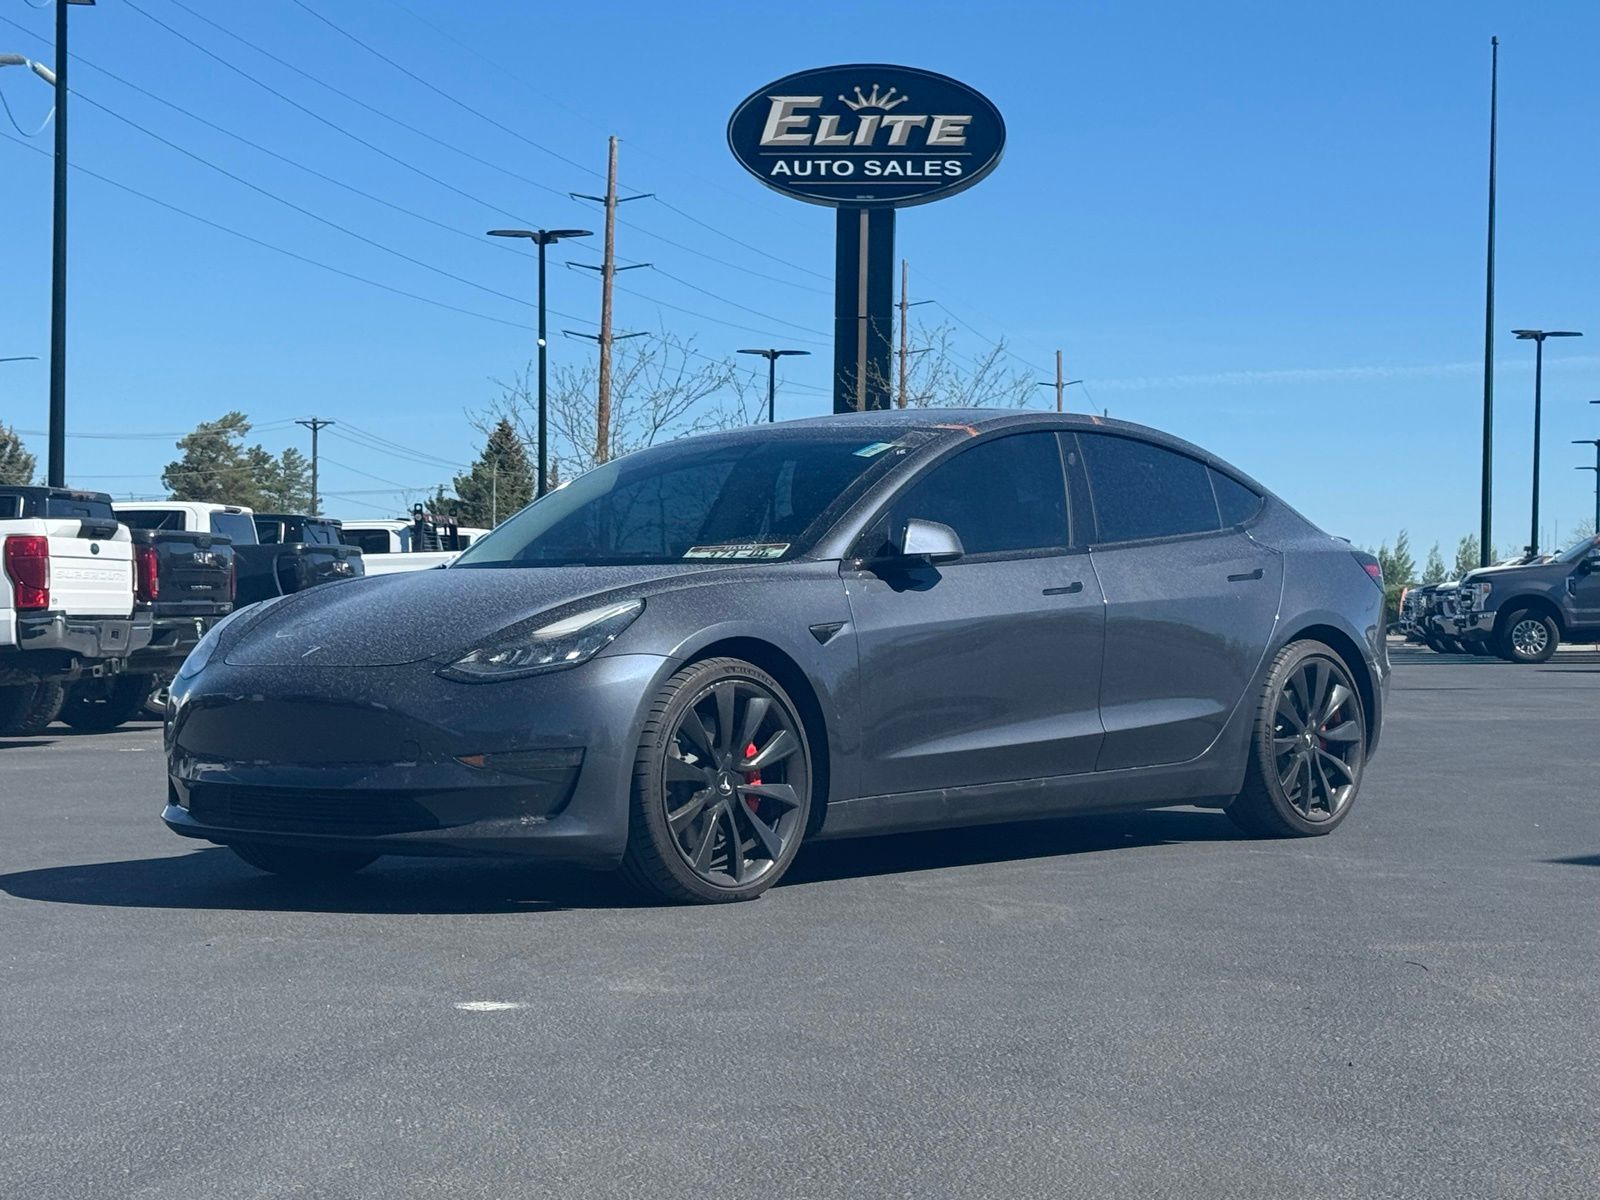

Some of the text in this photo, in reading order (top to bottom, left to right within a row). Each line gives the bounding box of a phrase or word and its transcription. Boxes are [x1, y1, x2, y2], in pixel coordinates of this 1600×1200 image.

[759, 95, 973, 146] ELITE
[770, 160, 963, 176] AUTO SALES
